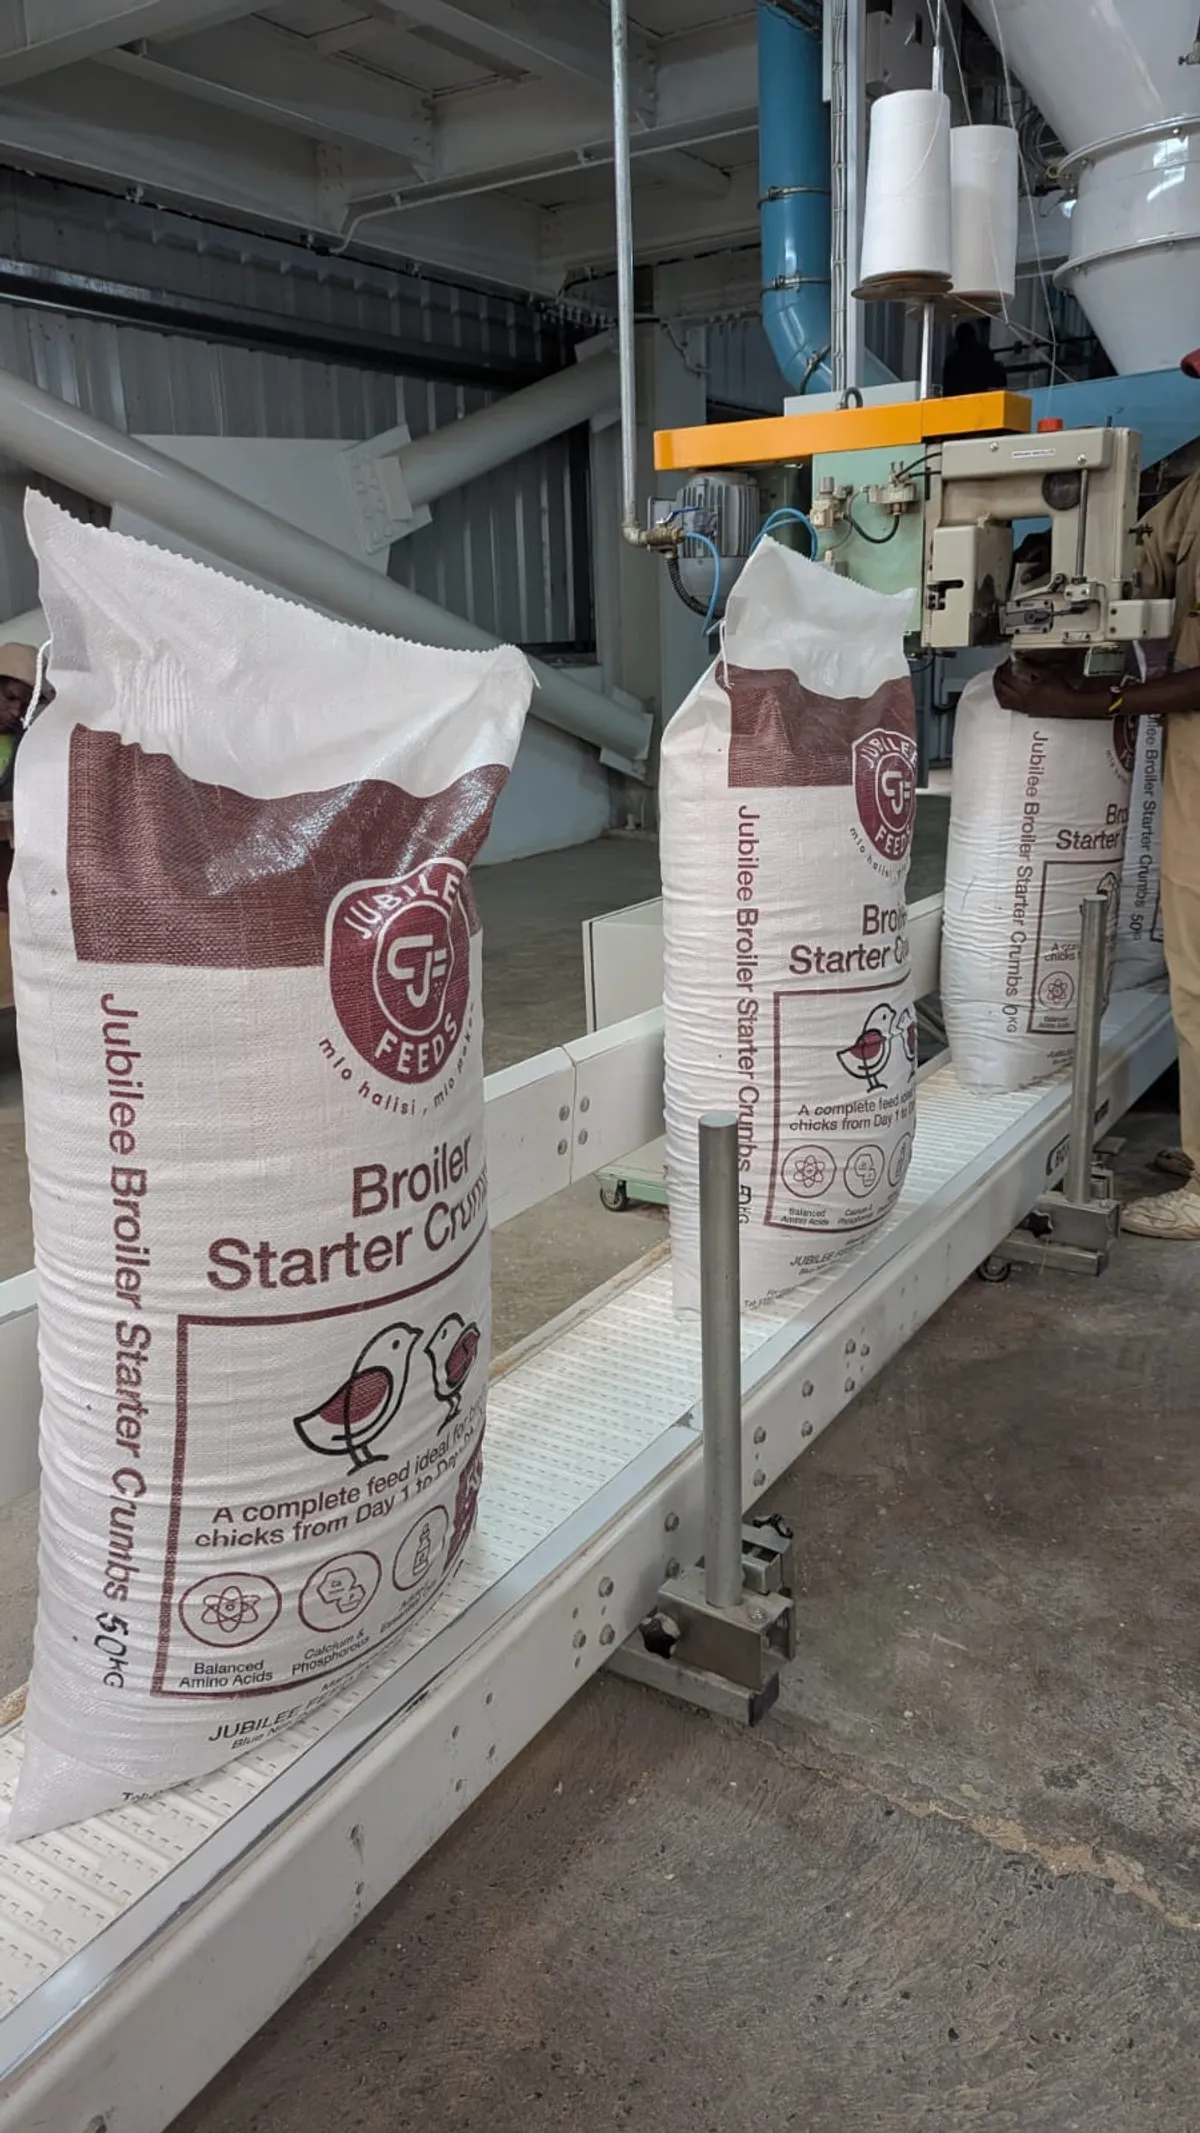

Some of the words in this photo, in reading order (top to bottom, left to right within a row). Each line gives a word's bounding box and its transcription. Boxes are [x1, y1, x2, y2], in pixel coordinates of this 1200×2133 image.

[1025, 731, 1049, 797] Jubilee
[736, 805, 760, 901] Jubilee
[1019, 802, 1040, 862] Broiler
[1056, 828, 1120, 850] Starter
[1012, 865, 1034, 927] Starter
[736, 908, 759, 993] Broiler
[788, 943, 891, 975] Starter
[1005, 931, 1027, 998] Crumbs
[374, 1011, 457, 1076] FEEDS
[737, 998, 759, 1080] Starter
[99, 992, 145, 1156] Jubilee
[738, 1086, 760, 1172] Crumbs
[789, 1119, 838, 1131] chicks
[842, 1116, 871, 1131] from
[798, 1103, 810, 1116] A
[814, 1100, 876, 1117] complete
[352, 1133, 472, 1219] Broiler
[110, 1164, 151, 1312] Broiler
[206, 1225, 414, 1292] Starter
[114, 1319, 152, 1460] Starter
[212, 1507, 234, 1524] A
[242, 1485, 361, 1521] complete
[366, 1465, 410, 1498] feed
[413, 1440, 451, 1476] ideal
[102, 1465, 148, 1602] Crumbs
[194, 1523, 285, 1548] chicks
[291, 1515, 348, 1543] from
[355, 1493, 396, 1525] Day
[178, 1673, 229, 1689] Amino
[232, 1669, 274, 1687] Acids
[193, 1659, 264, 1676] Balanced
[208, 1704, 303, 1742] JUBILEE
